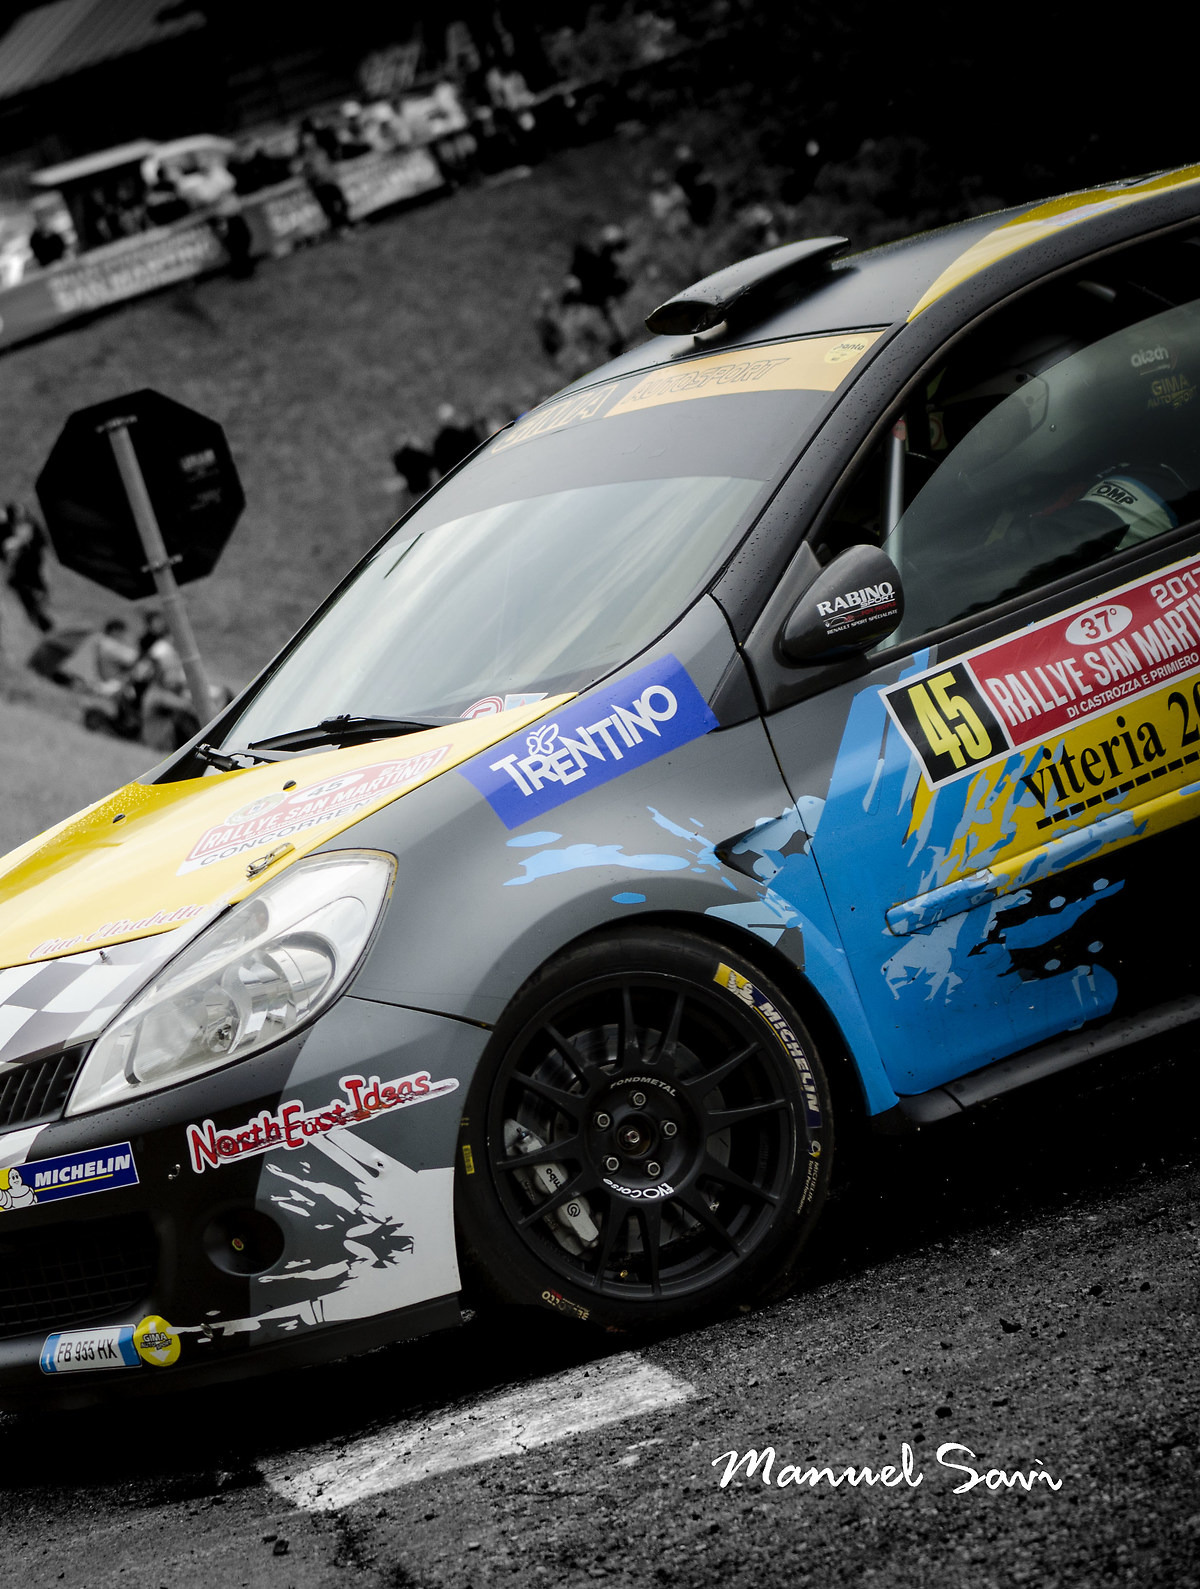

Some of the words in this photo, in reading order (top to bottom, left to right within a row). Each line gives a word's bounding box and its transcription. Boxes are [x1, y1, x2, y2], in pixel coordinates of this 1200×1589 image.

[631, 357, 791, 401] AUTOSPORT
[1151, 372, 1191, 396] GIMA
[1097, 484, 1135, 506] OMP
[816, 582, 893, 617] RABINO
[860, 591, 896, 609] SPORT
[827, 624, 851, 635] RENAULT
[851, 618, 868, 627] SPORT
[985, 657, 1093, 728] RALLYE
[1083, 637, 1143, 687] SAN
[1131, 590, 1200, 667] MARTI
[1066, 706, 1080, 719] DI
[1080, 678, 1142, 712] CASTROZZA
[1142, 674, 1151, 685] E
[1150, 652, 1200, 682] PRIMIERO
[907, 670, 994, 770] 45
[489, 685, 678, 796] TRENTINO
[1020, 715, 1167, 810] viteria
[208, 811, 285, 850] RALLYE
[284, 796, 334, 821] SAN
[330, 758, 437, 810] MARTINO
[307, 779, 346, 799] 45
[29, 938, 83, 960] Ciao
[758, 1000, 820, 1113] MICHELIN
[343, 1074, 430, 1113] Ideas
[609, 1075, 677, 1098] FONDMETAL
[35, 1153, 131, 1187] MICHELIN
[807, 1160, 820, 1202] MICHELIN
[57, 1342, 73, 1363] FB
[75, 1340, 95, 1361] 955
[97, 1338, 118, 1360] HX
[143, 1332, 168, 1342] GIMA
